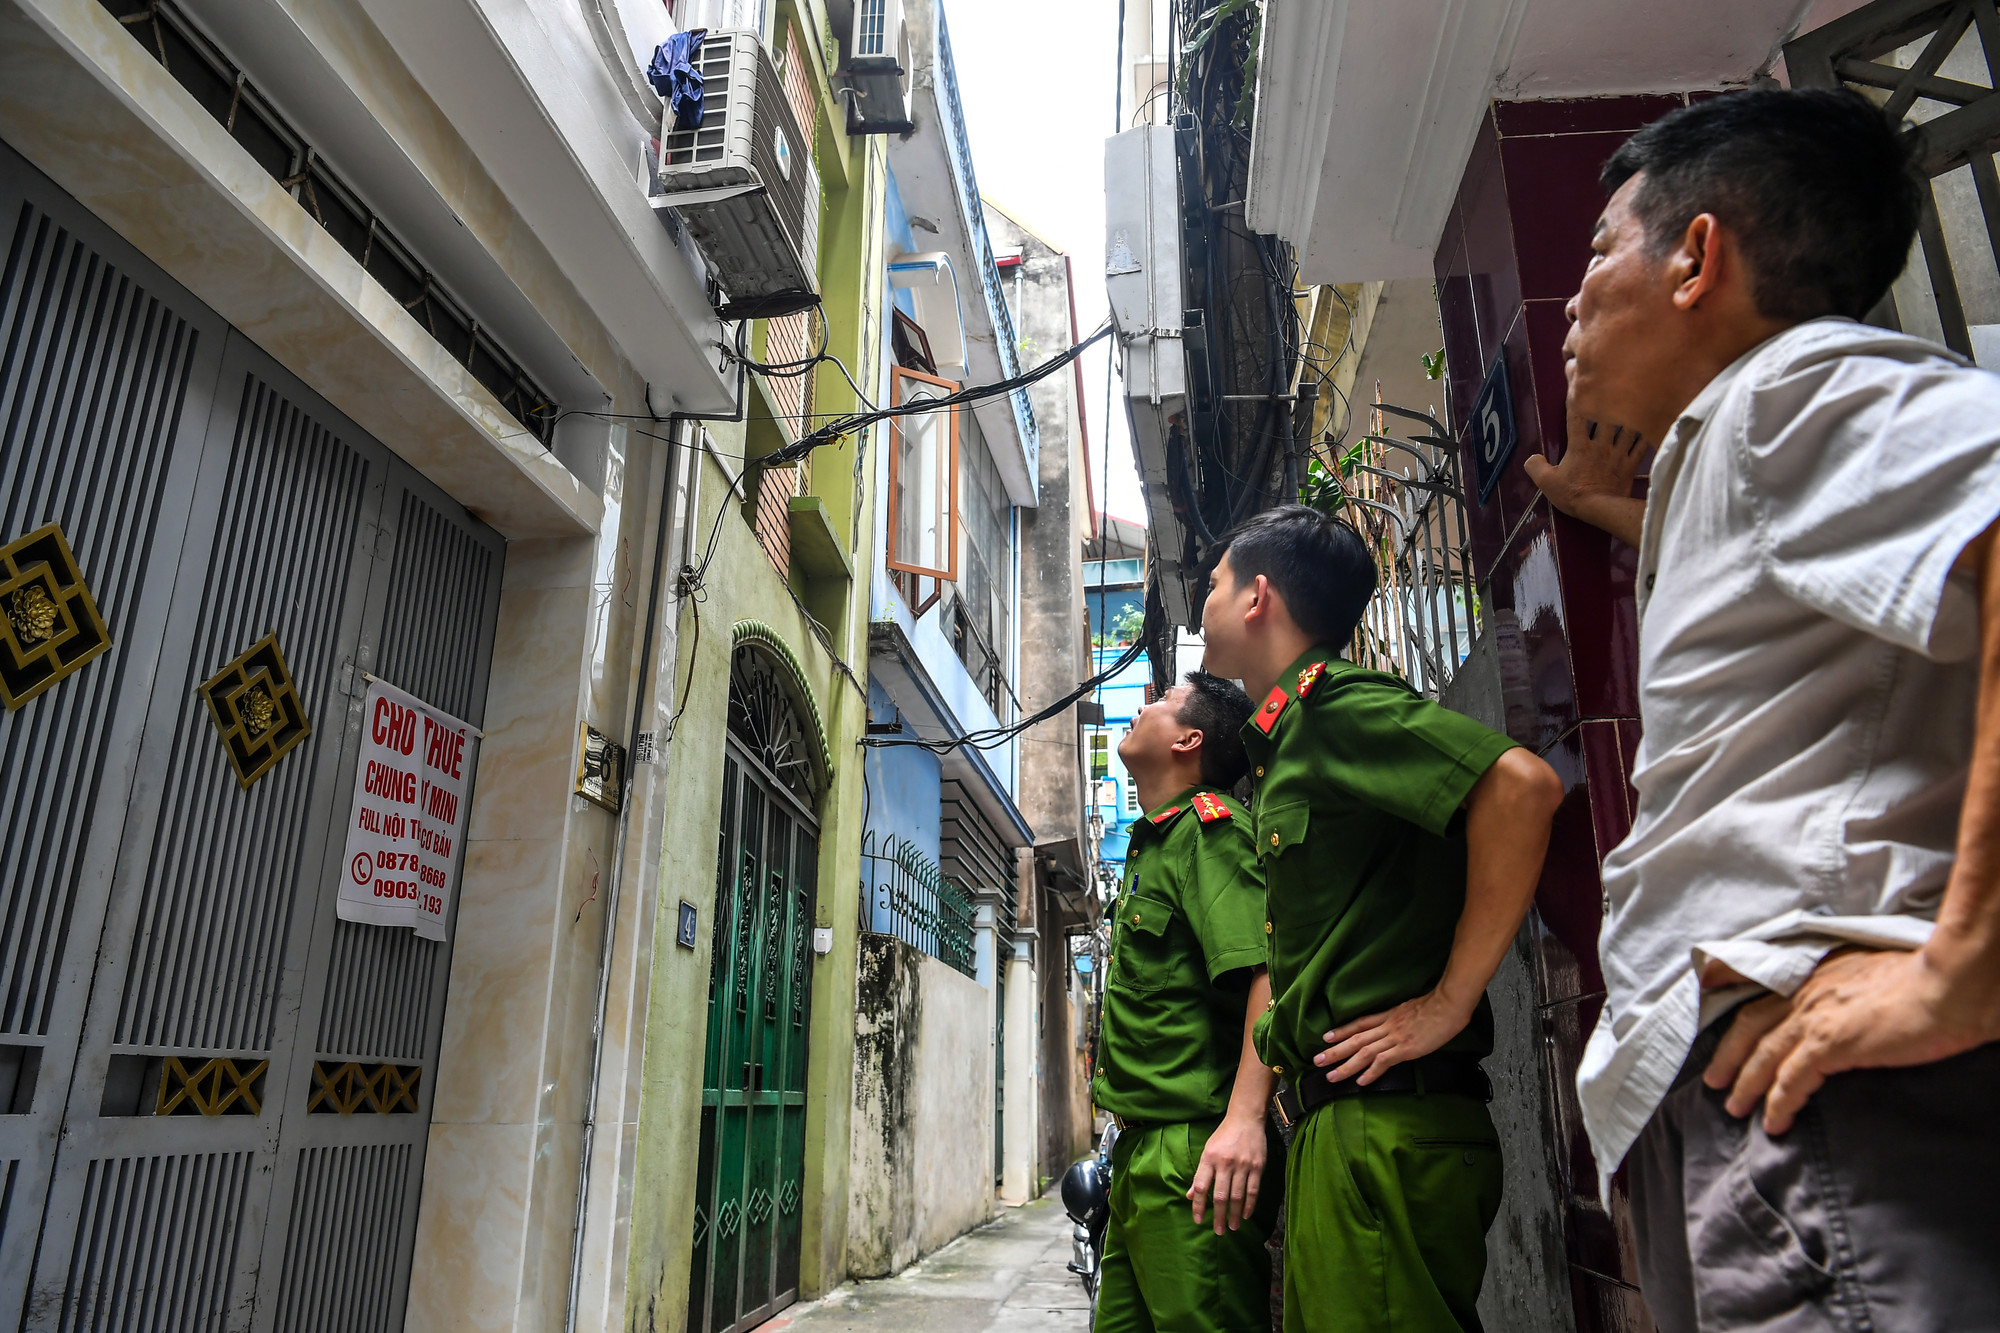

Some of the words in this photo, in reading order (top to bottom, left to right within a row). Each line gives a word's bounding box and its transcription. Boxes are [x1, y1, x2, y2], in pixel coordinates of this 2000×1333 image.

[1482, 387, 1500, 463] 5
[372, 696, 417, 756] CHO
[364, 759, 417, 804] CHUNG
[421, 778, 431, 811] Ư
[428, 784, 458, 825] MINI
[601, 743, 613, 782] 6
[358, 806, 381, 834] FULL
[382, 812, 405, 842] NỘI
[420, 828, 434, 851] CƠ
[433, 829, 452, 859] BẢN
